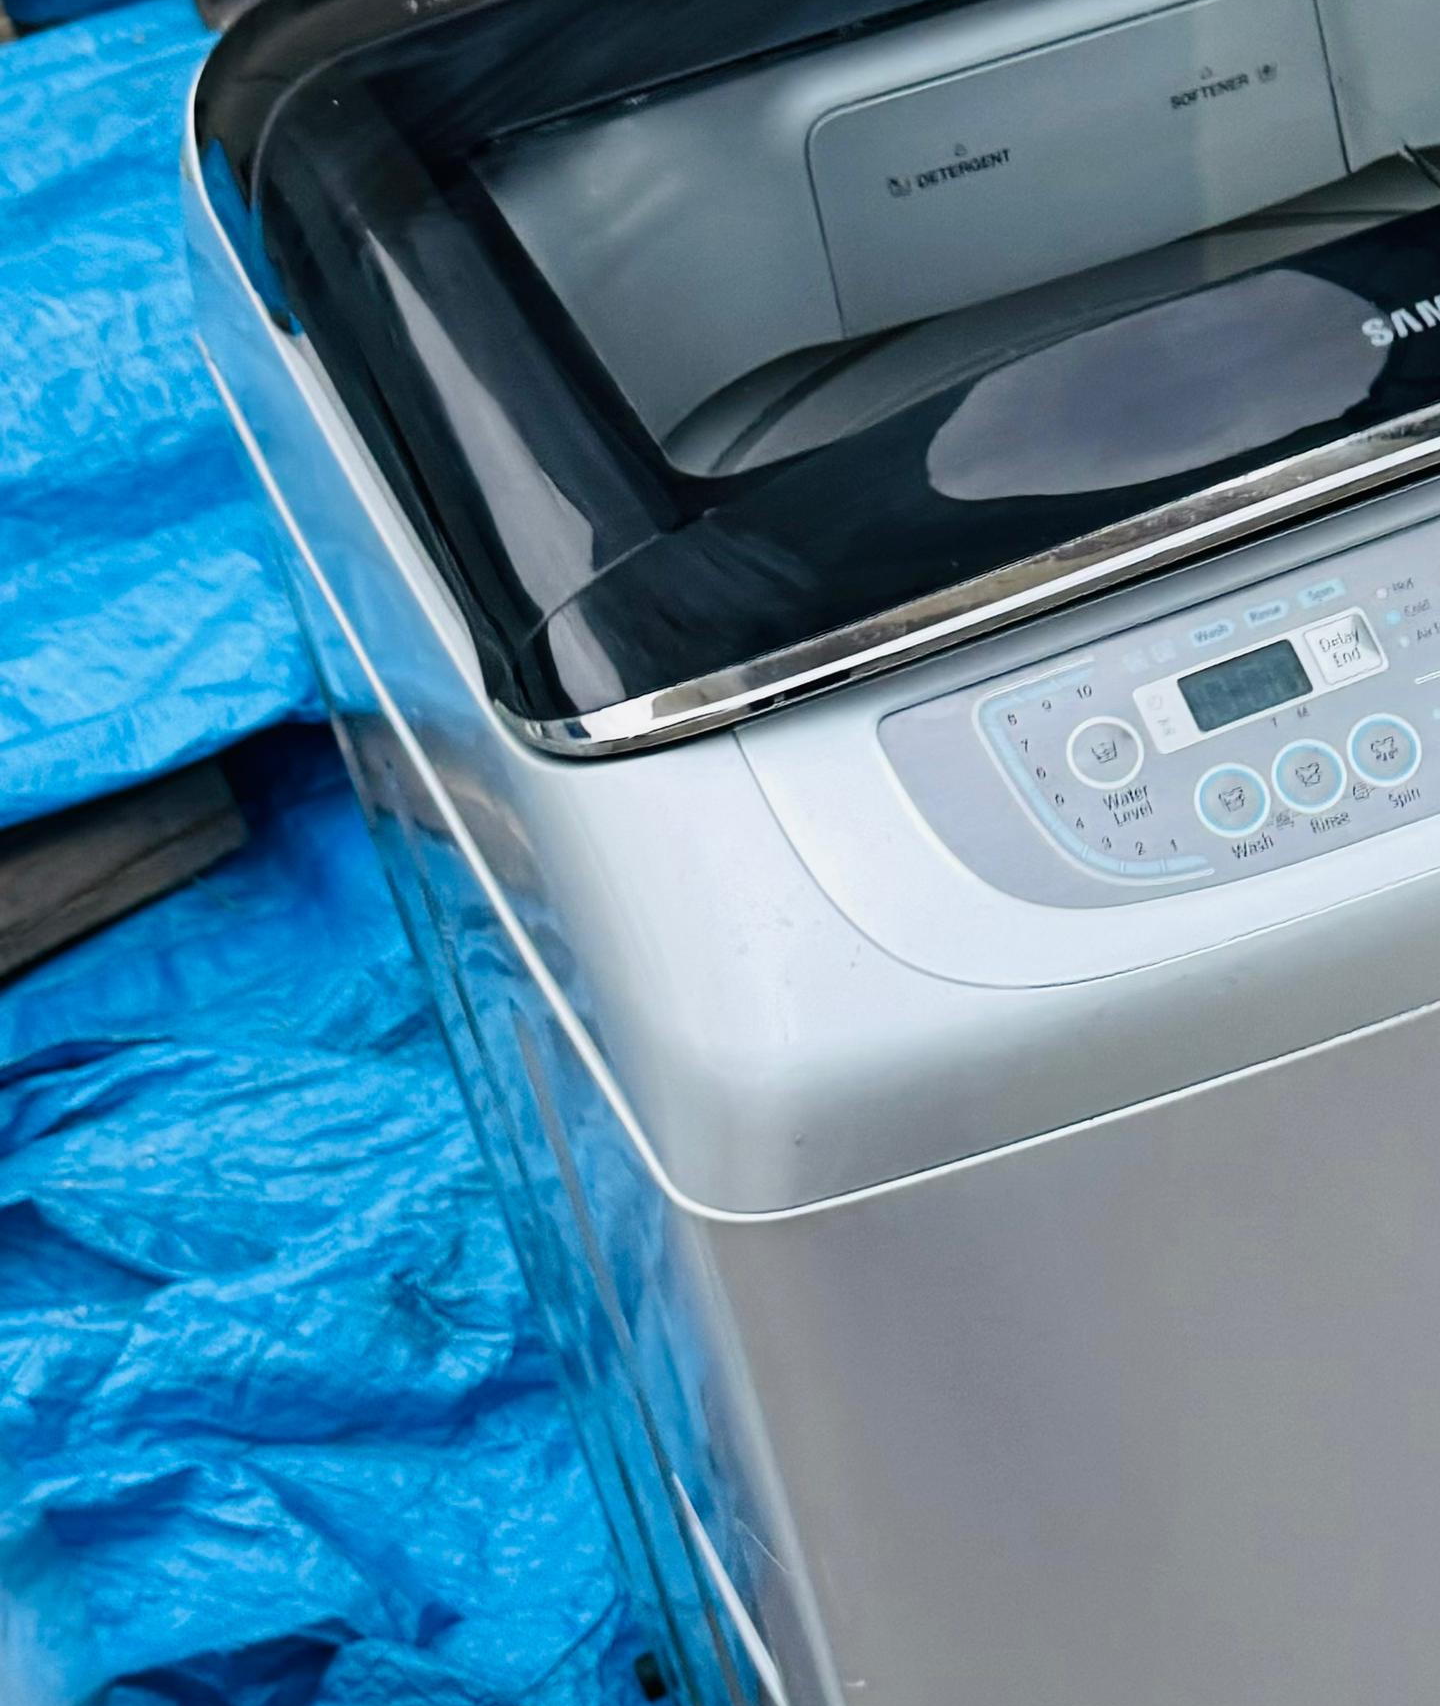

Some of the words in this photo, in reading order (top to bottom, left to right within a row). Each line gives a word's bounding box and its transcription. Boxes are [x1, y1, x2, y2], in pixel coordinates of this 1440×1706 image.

[1170, 73, 1250, 110] SOFTENER
[916, 147, 1012, 190] DETERGENT
[1318, 626, 1360, 653] Delay
[1101, 783, 1150, 812] Water
[1230, 832, 1275, 860] Wash
